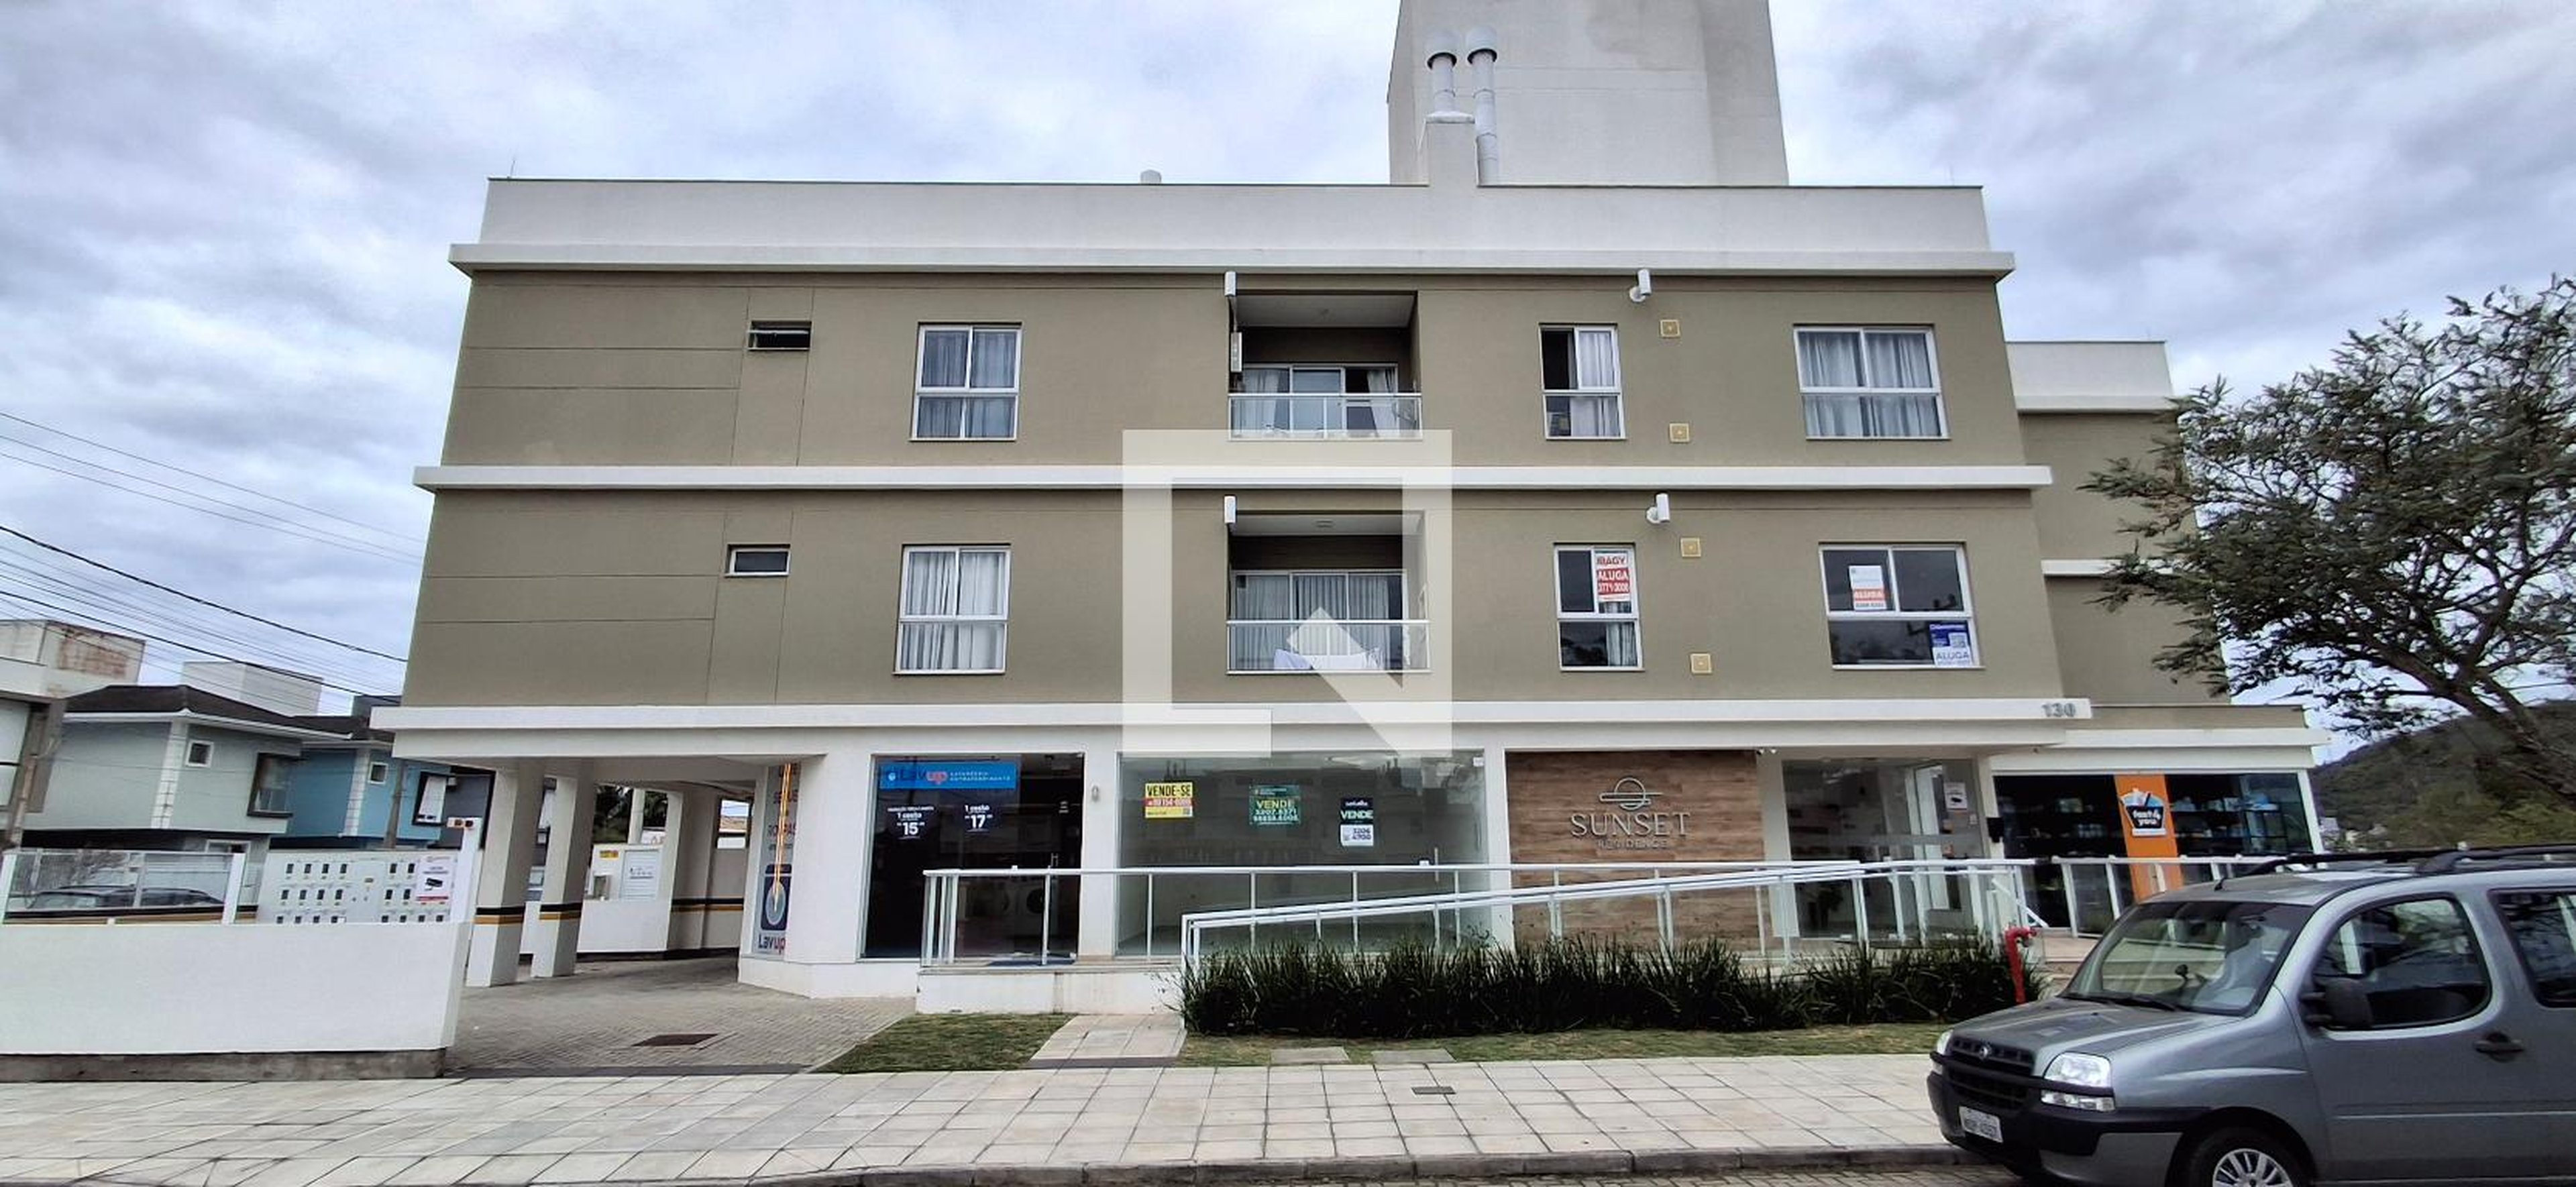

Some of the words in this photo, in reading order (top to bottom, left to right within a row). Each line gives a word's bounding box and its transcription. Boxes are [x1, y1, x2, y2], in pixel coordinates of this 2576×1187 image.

[1598, 569, 1629, 581] ALUGA
[1936, 651, 1970, 661] ALUGA
[2041, 702, 2076, 718] 130
[1146, 785, 1191, 797] VENDE-SE
[1256, 799, 1296, 809] VENDE
[1340, 809, 1374, 819] VENDE
[971, 814, 985, 828] 17
[1570, 812, 1690, 837] SUNSET
[903, 822, 918, 835] 15
[1598, 838, 1668, 850] RESIDENCE
